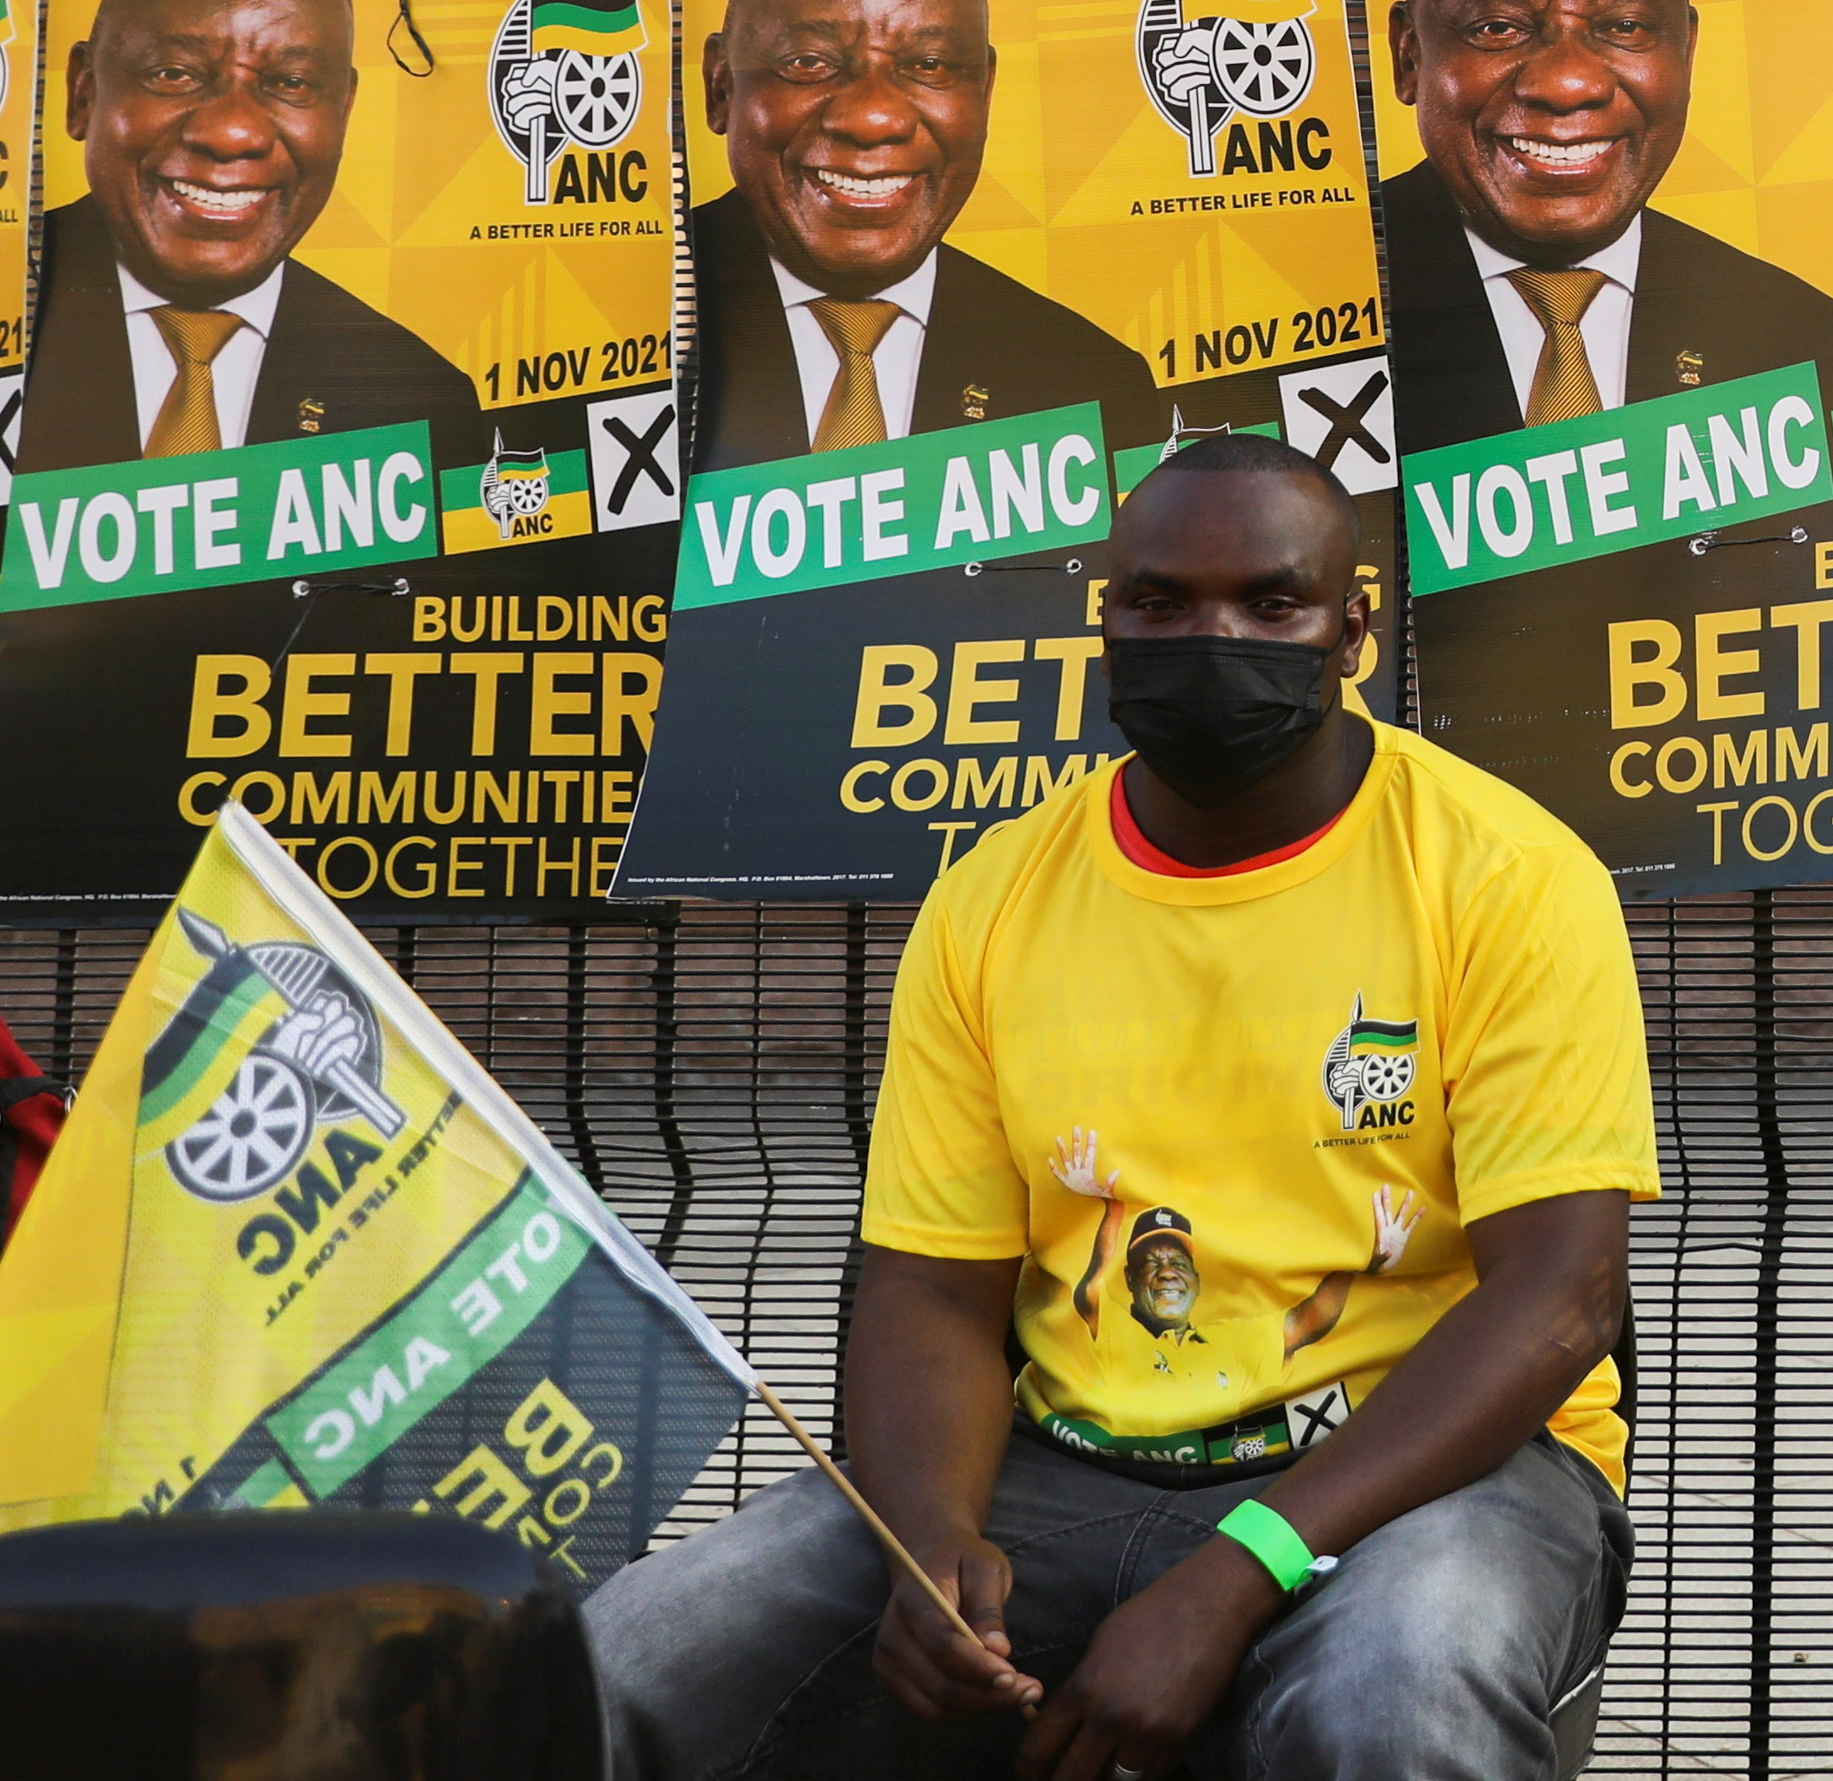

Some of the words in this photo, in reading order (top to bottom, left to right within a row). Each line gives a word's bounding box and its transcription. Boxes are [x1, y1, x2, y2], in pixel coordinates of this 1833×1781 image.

[1222, 118, 1331, 175] ANC
[554, 151, 647, 204] ANC
[1131, 202, 1143, 215] A
[1151, 196, 1225, 214] BETTER
[1232, 192, 1272, 208] LIFE
[1279, 190, 1315, 205] FOR
[1322, 188, 1355, 202] ALL
[0, 209, 18, 223] LL
[470, 226, 481, 239] A
[488, 224, 554, 239] BETTER
[560, 223, 594, 237] LIFE
[601, 222, 630, 235] FOR
[636, 221, 663, 234] ALL
[0, 316, 21, 357] 21
[1160, 339, 1175, 378] 1
[1196, 318, 1278, 372] NOV
[1293, 297, 1378, 352] 2021
[486, 363, 499, 400] 1
[517, 347, 590, 396] NOV
[601, 330, 671, 381] 2021
[1414, 438, 1637, 569] VOTE
[1663, 396, 1819, 520] ANC
[19, 478, 241, 589] VOTE
[267, 452, 426, 560] ANC
[513, 514, 552, 537] ANC
[695, 468, 908, 586] VOTE
[934, 435, 1099, 549] ANC
[413, 595, 666, 642] BUILDING
[187, 653, 664, 758] BETTER
[177, 770, 646, 826] COMMUNITIE
[275, 835, 629, 899] OGETHE
[1313, 1140, 1321, 1149] A
[1322, 1138, 1356, 1148] BETTER
[1394, 1132, 1411, 1140] ALL
[1358, 1100, 1415, 1130] ANC
